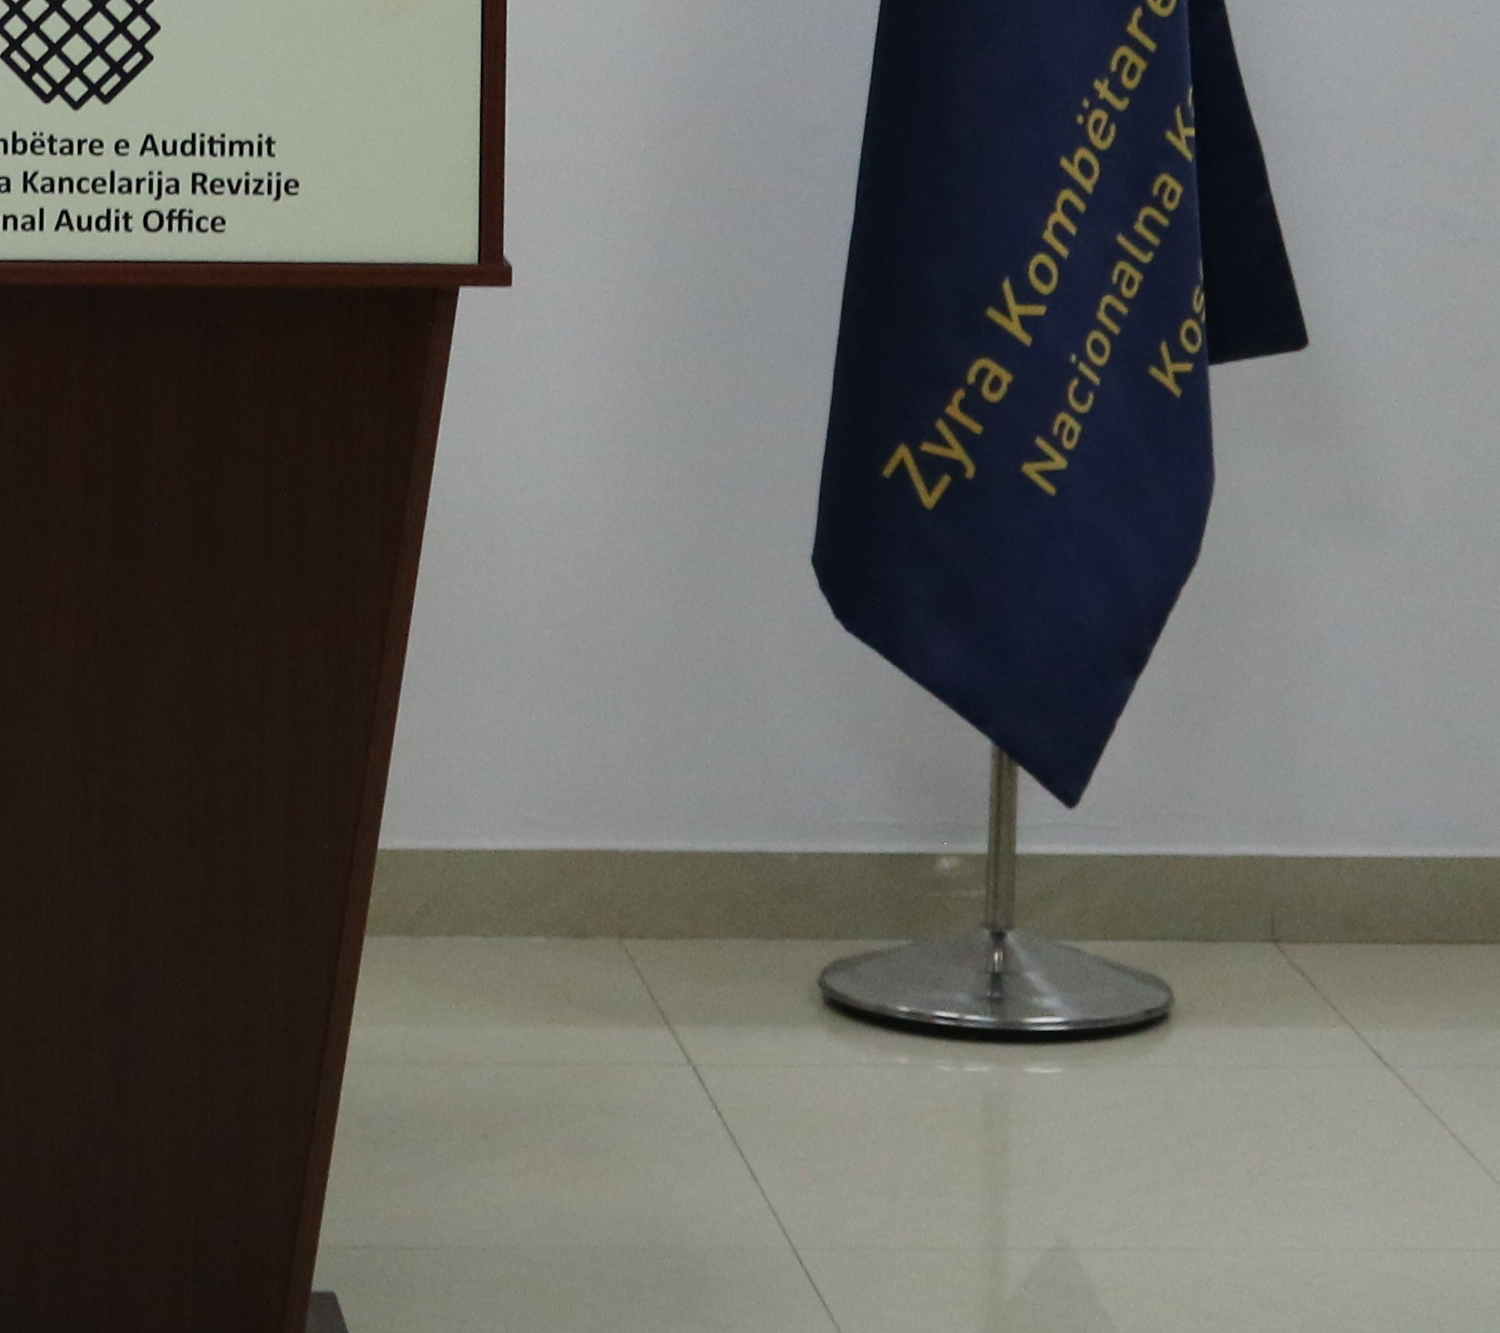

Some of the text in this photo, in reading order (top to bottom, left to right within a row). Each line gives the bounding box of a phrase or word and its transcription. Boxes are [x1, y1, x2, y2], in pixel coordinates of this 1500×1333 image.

[113, 139, 131, 157] e
[138, 132, 277, 159] Auditimit
[21, 169, 181, 200] Kancelarija
[190, 171, 300, 202] Revizije
[54, 208, 134, 234] Audit
[142, 209, 227, 234] Office
[1020, 170, 1185, 497] Nacionalna
[881, 355, 1014, 511] Zyra
